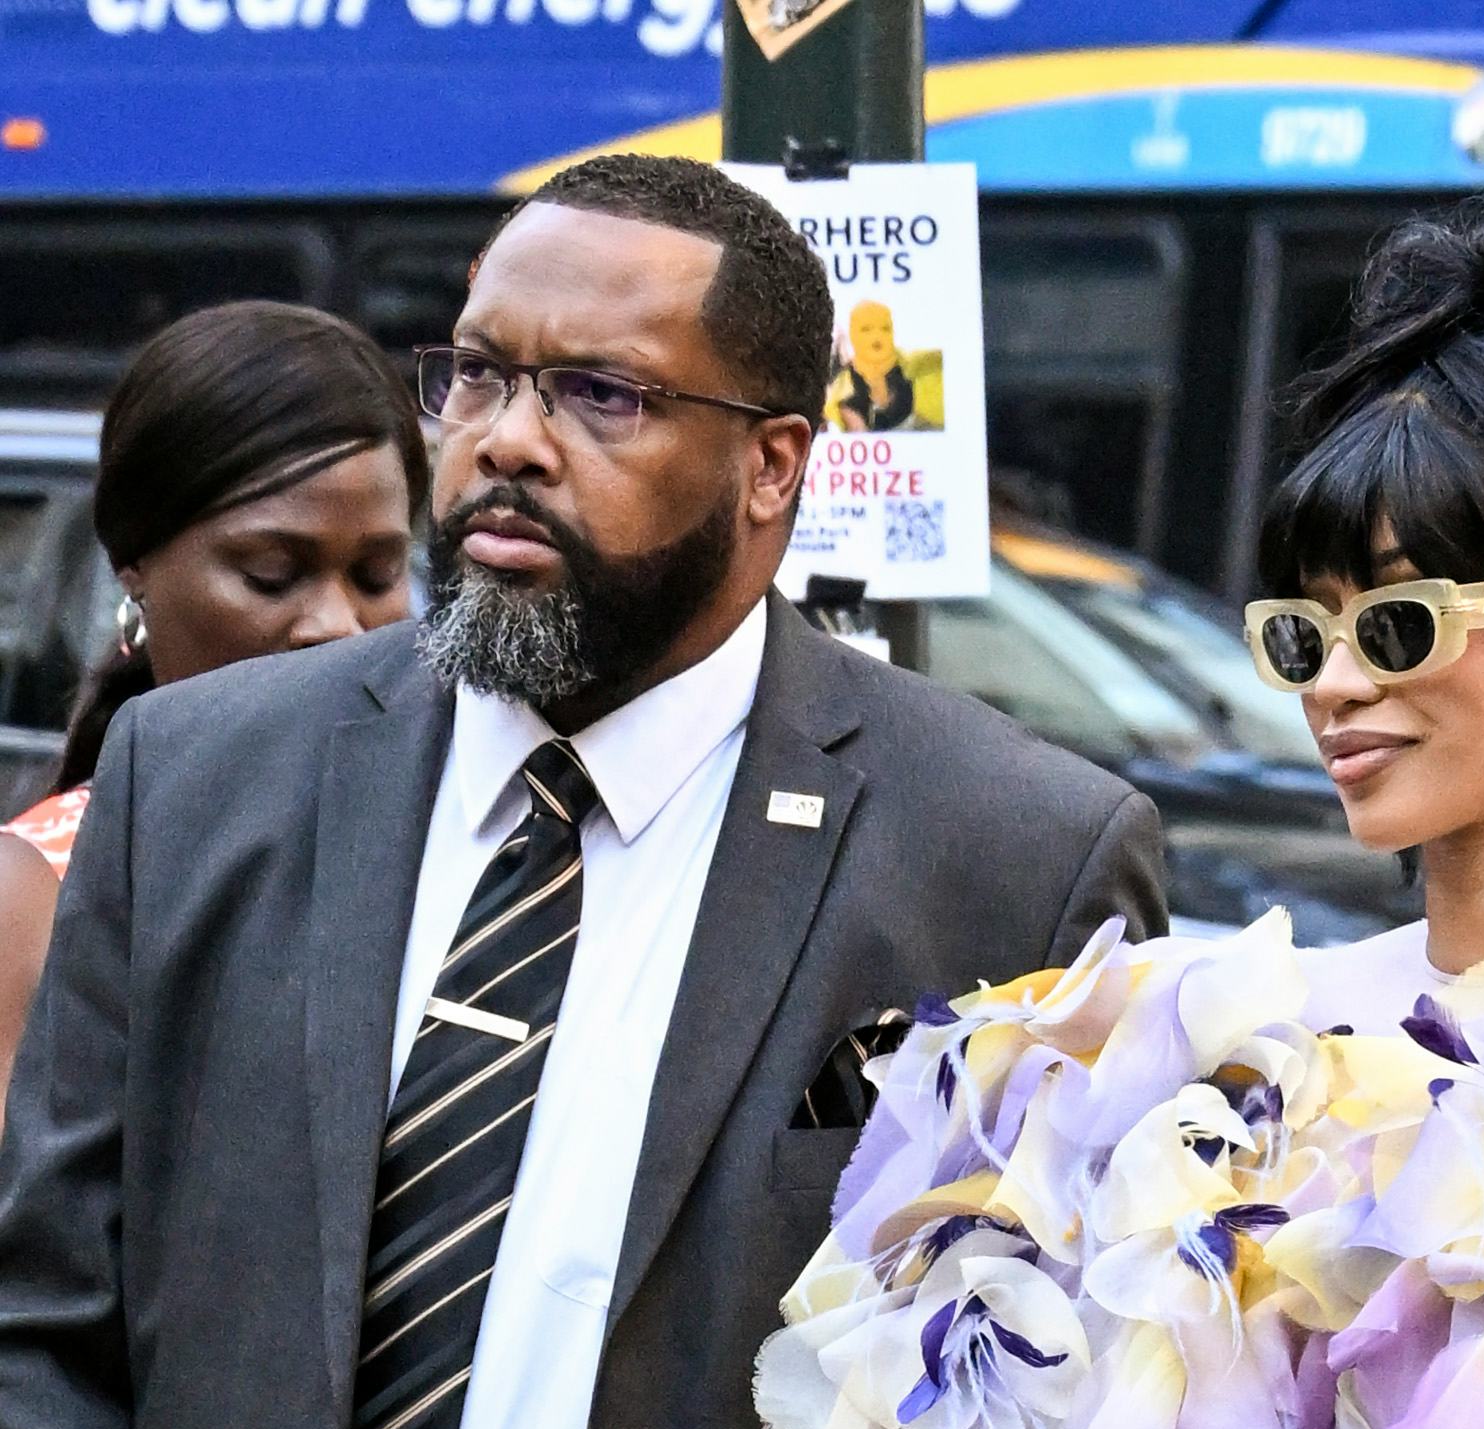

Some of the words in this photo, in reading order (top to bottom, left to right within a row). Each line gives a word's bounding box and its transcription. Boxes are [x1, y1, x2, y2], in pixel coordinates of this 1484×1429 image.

[799, 215, 938, 246] RHERO
[833, 252, 912, 283] UTS
[816, 440, 892, 470] ,000
[829, 470, 924, 496] PRIZE
